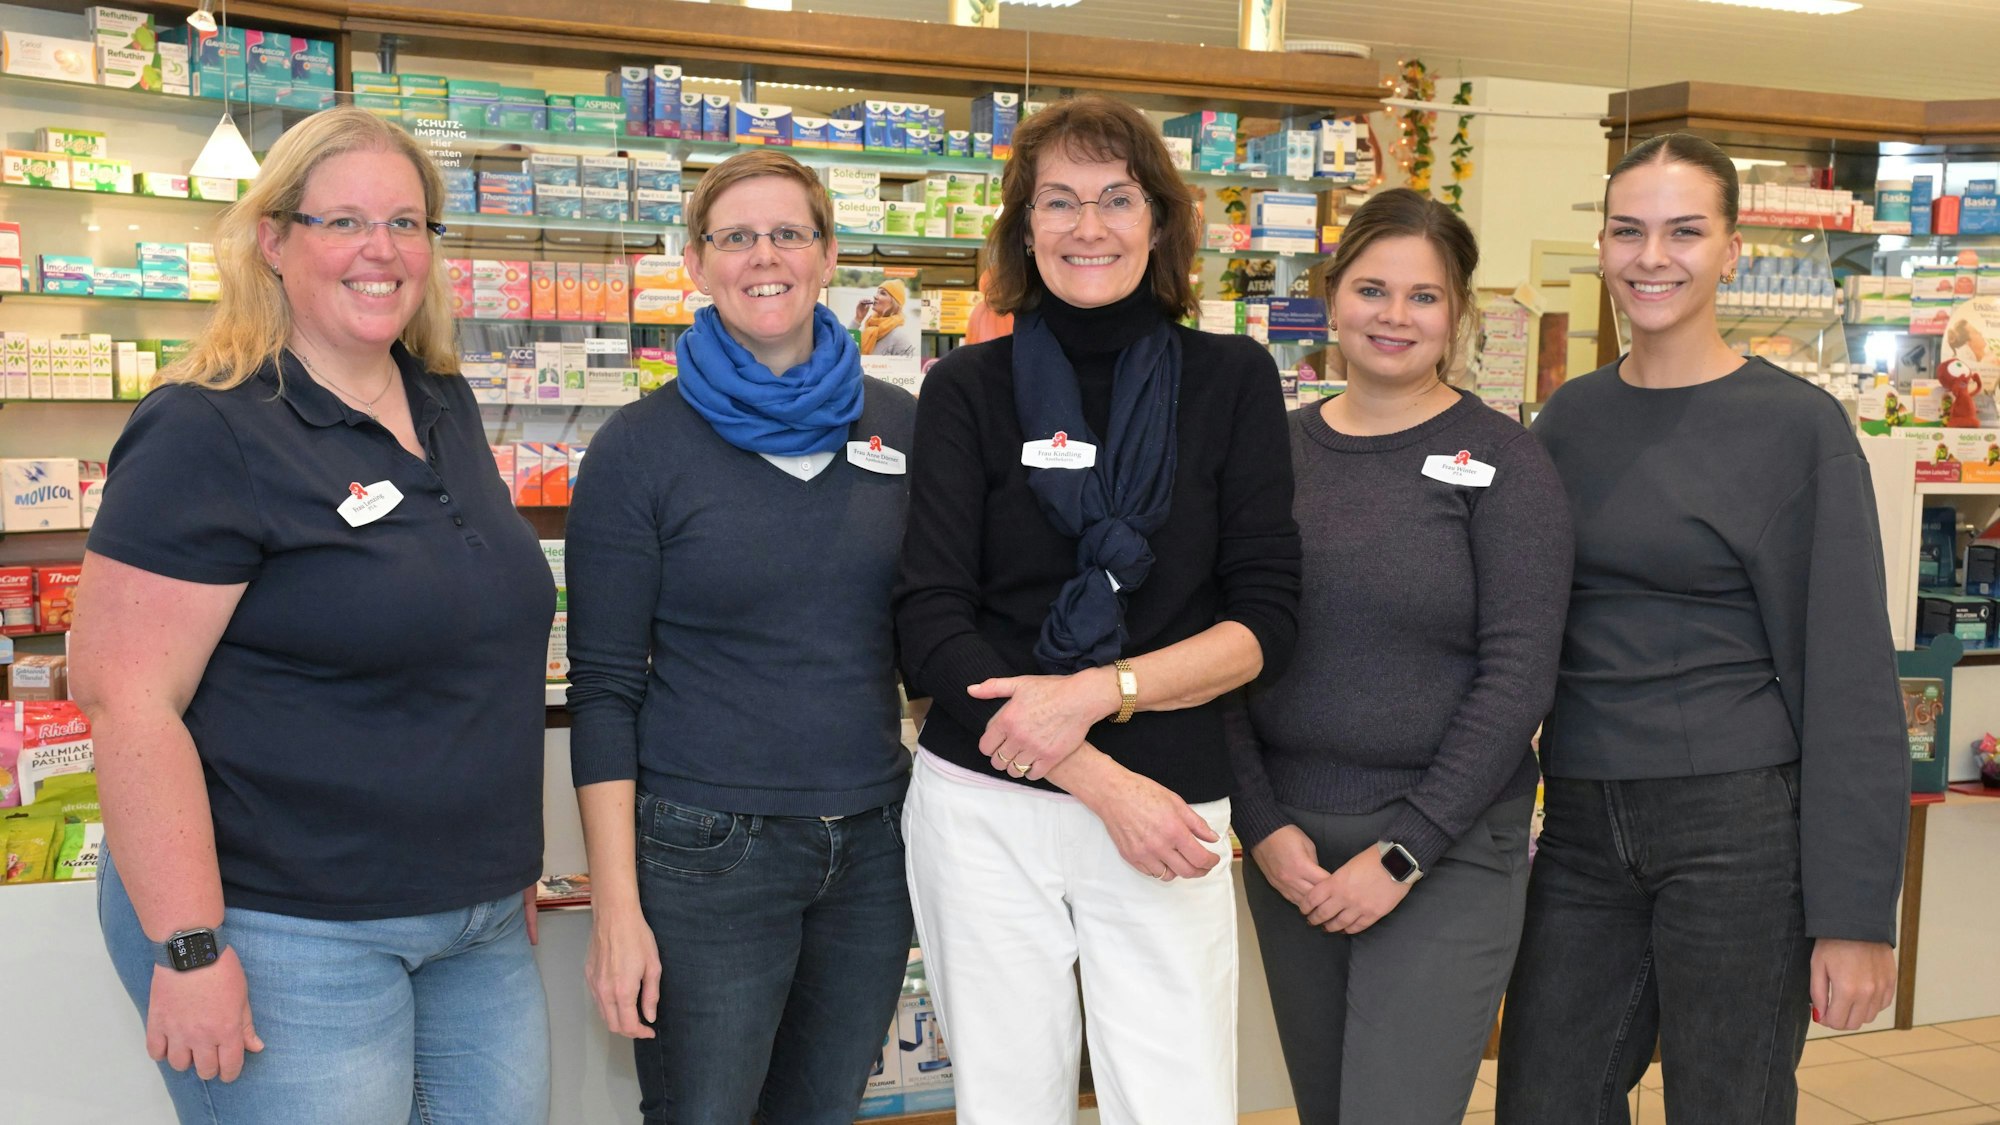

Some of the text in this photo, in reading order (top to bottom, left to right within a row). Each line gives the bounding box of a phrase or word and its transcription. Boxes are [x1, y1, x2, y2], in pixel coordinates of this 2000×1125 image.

[99, 9, 138, 22] Refluthin
[107, 48, 146, 61] Refluthin
[584, 100, 622, 110] ASPIRIN
[416, 119, 464, 129] SCHUTZ-
[414, 128, 467, 139] IMPFUNG
[55, 138, 100, 152] Buscopan
[431, 139, 452, 148] Hier
[13, 162, 59, 176] Buscopan
[833, 168, 876, 179] Soledum
[482, 171, 530, 182] Thomapyrin
[482, 193, 530, 202] Thomapyrin
[1881, 193, 1911, 203] Basica
[1964, 197, 1997, 207] Basica
[838, 202, 880, 212] Soledum
[143, 246, 177, 255] Imodium
[46, 263, 84, 272] Imodium
[94, 271, 131, 280] Imodium
[145, 273, 179, 282] Imodium
[639, 293, 680, 301] Grippostad
[463, 354, 480, 362] ACC
[509, 350, 534, 360] ACC
[1441, 463, 1455, 471] Frau
[15, 485, 74, 506] MOVICOL
[39, 720, 88, 740] Rheila
[34, 743, 91, 759] SALMIAK
[869, 1080, 896, 1088] TOLERIANE
